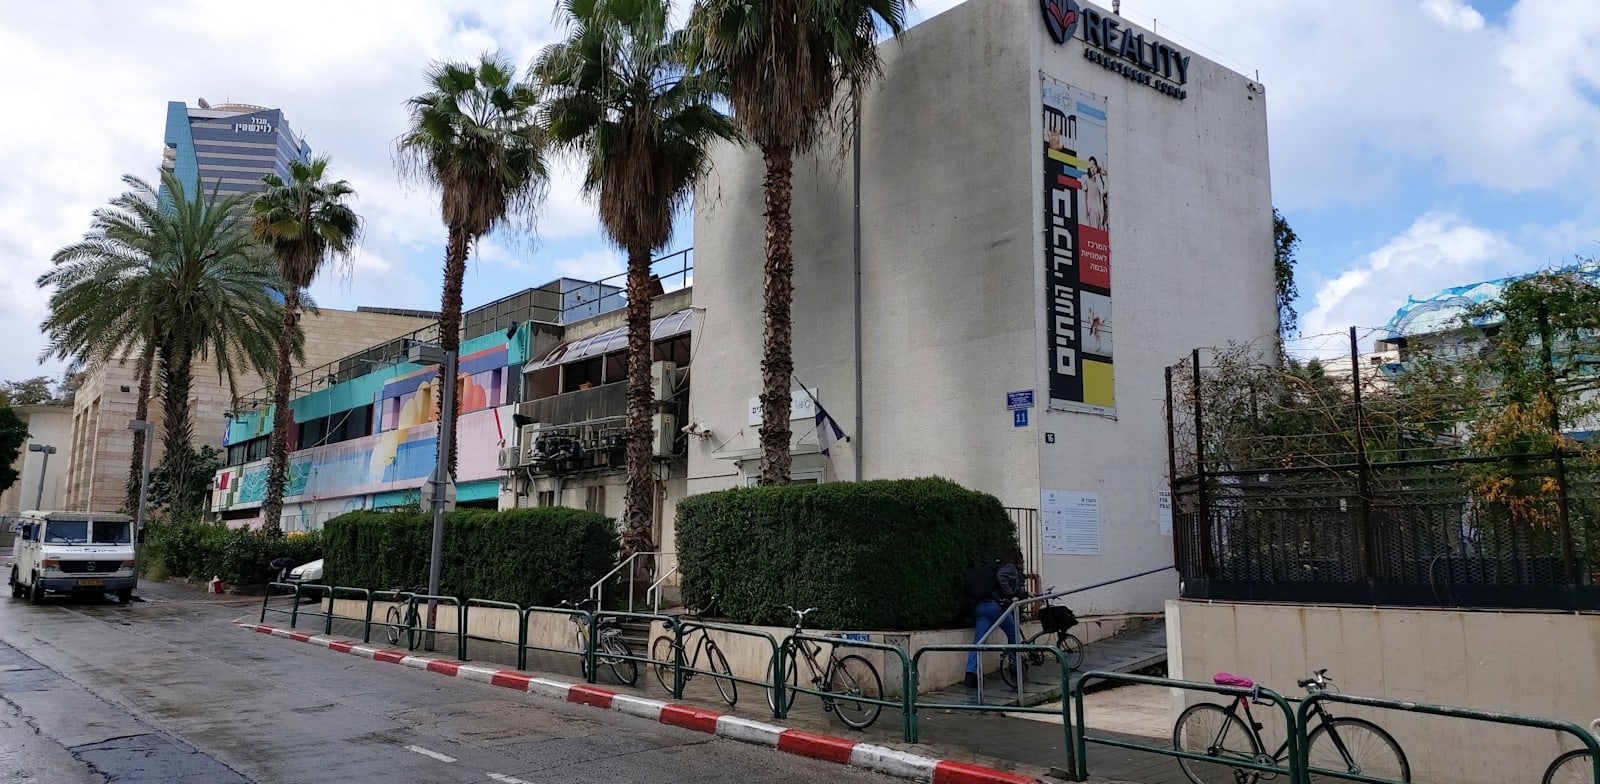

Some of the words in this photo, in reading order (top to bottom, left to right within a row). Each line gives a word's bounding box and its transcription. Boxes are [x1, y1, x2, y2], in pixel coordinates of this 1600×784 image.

[1083, 8, 1190, 84] REALITY
[1084, 48, 1151, 85] INVESTMENT
[251, 116, 267, 124] מגדל
[1052, 188, 1073, 278] ביכורי
[1087, 240, 1108, 252] המרכז
[1080, 249, 1108, 262] לאמנויות
[1089, 262, 1108, 274] הבמה
[1055, 284, 1076, 377] העתים
[1015, 412, 1026, 423] 11
